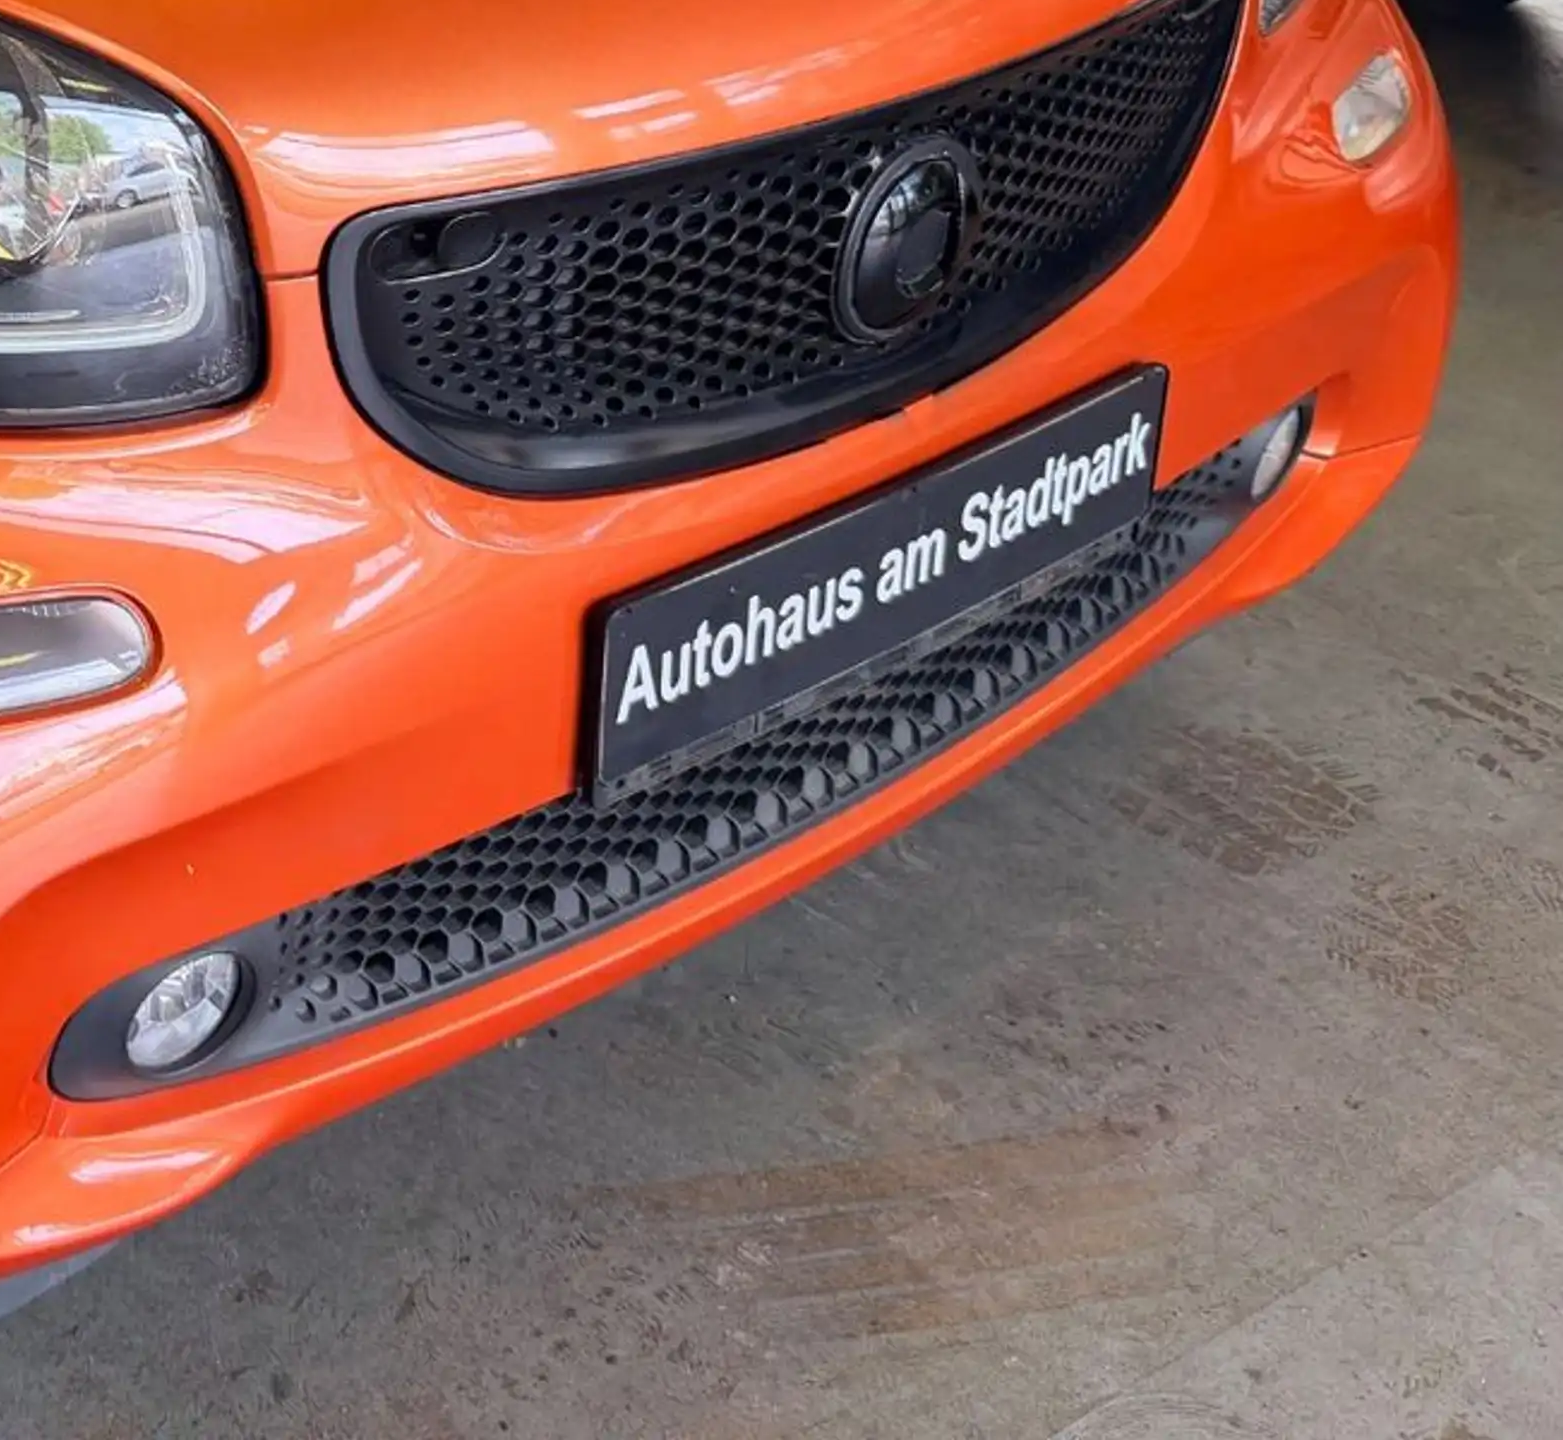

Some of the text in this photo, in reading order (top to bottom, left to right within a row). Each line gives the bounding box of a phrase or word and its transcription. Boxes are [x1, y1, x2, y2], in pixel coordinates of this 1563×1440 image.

[616, 411, 1153, 726] Autohaus am Stadtpark
